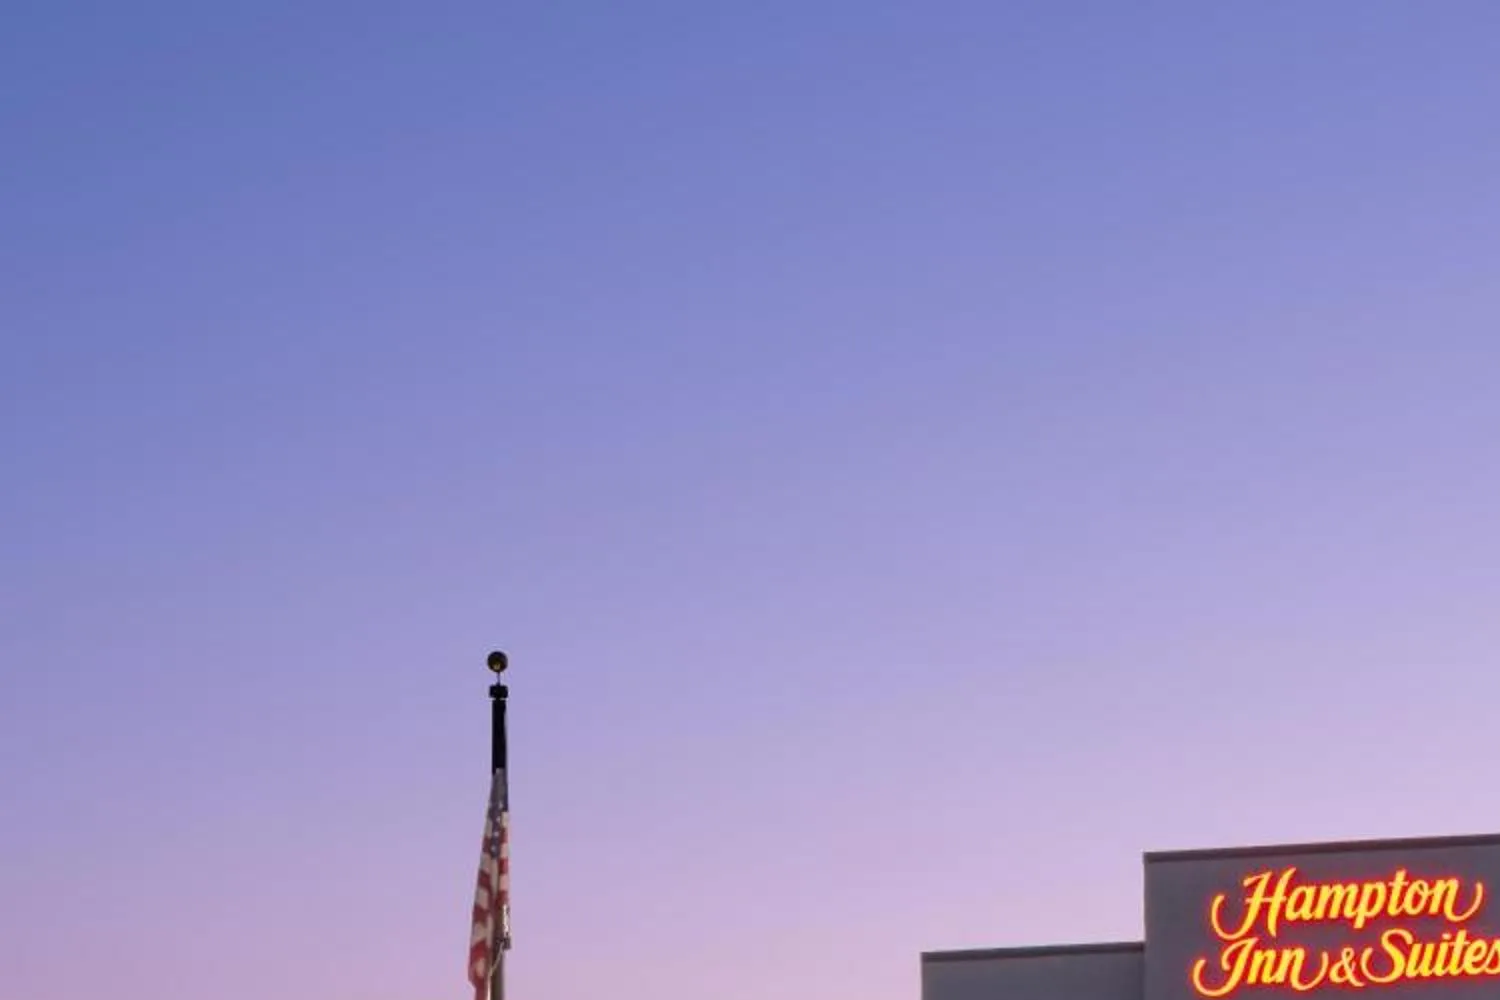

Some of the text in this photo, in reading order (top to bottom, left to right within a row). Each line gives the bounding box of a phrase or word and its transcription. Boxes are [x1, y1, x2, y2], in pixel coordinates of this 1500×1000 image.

[1211, 867, 1484, 940] Hampton
[1193, 937, 1329, 997] Inn
[1330, 947, 1366, 987] &
